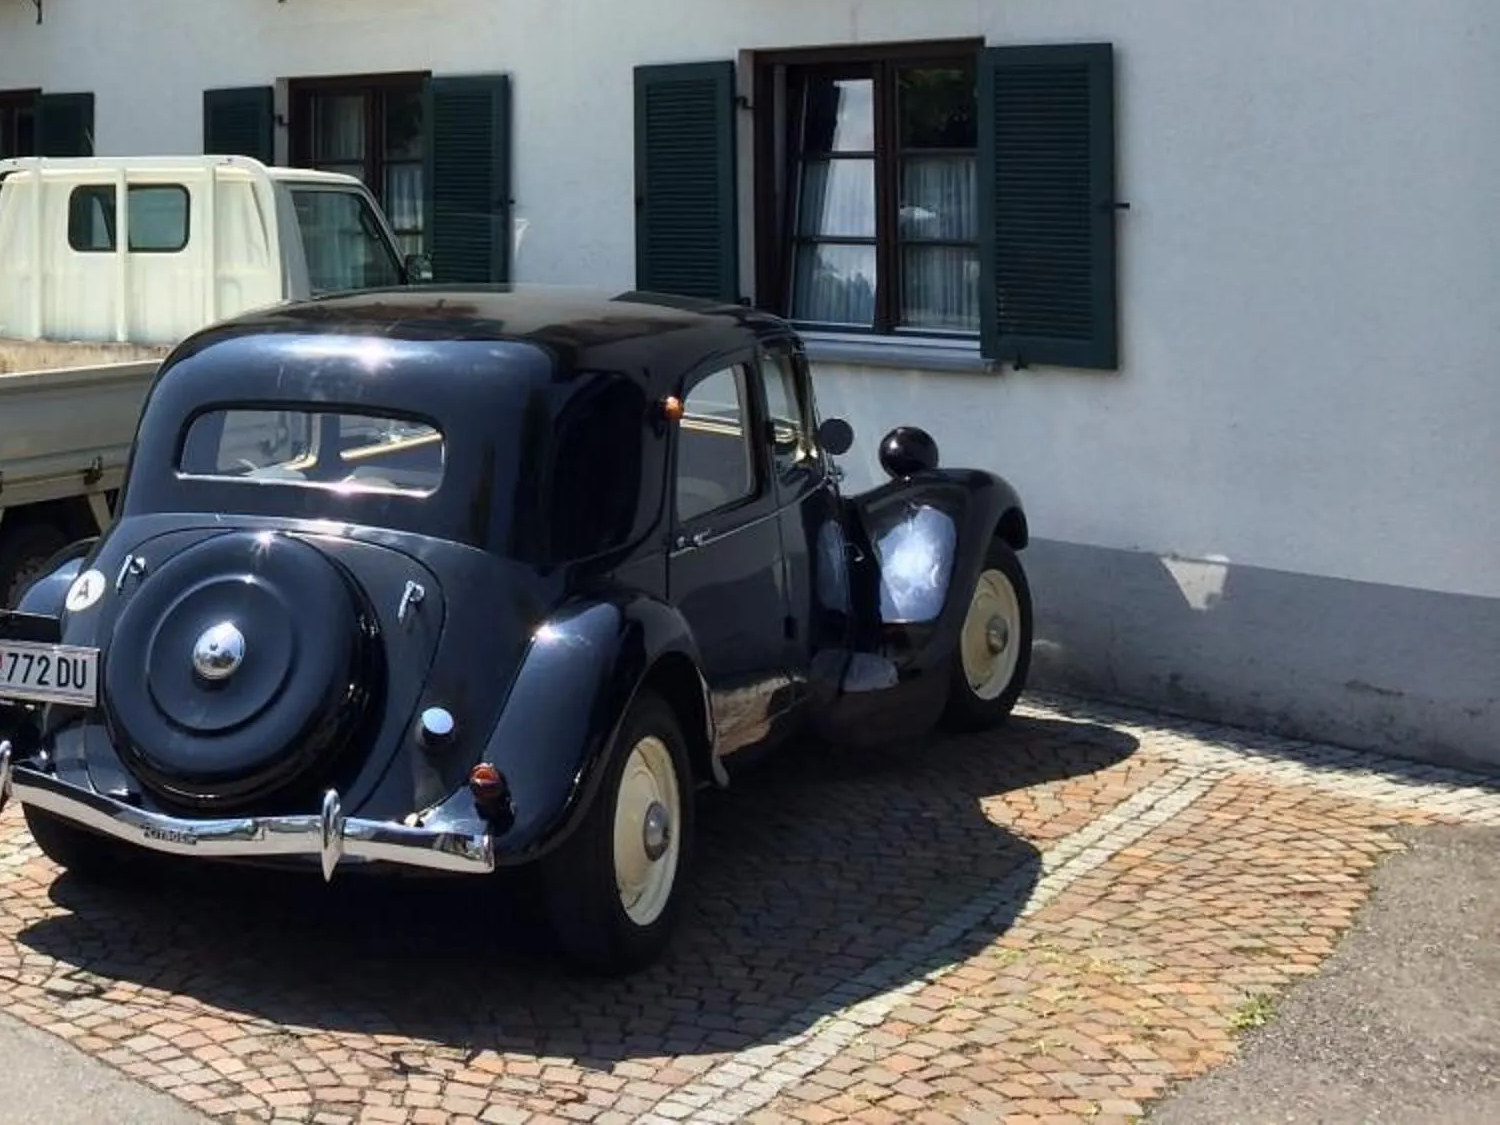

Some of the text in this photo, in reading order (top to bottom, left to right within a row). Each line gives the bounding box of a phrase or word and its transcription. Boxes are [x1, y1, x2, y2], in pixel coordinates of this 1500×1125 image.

[74, 579, 89, 600] A
[7, 652, 49, 686] 772
[57, 656, 87, 689] DU
